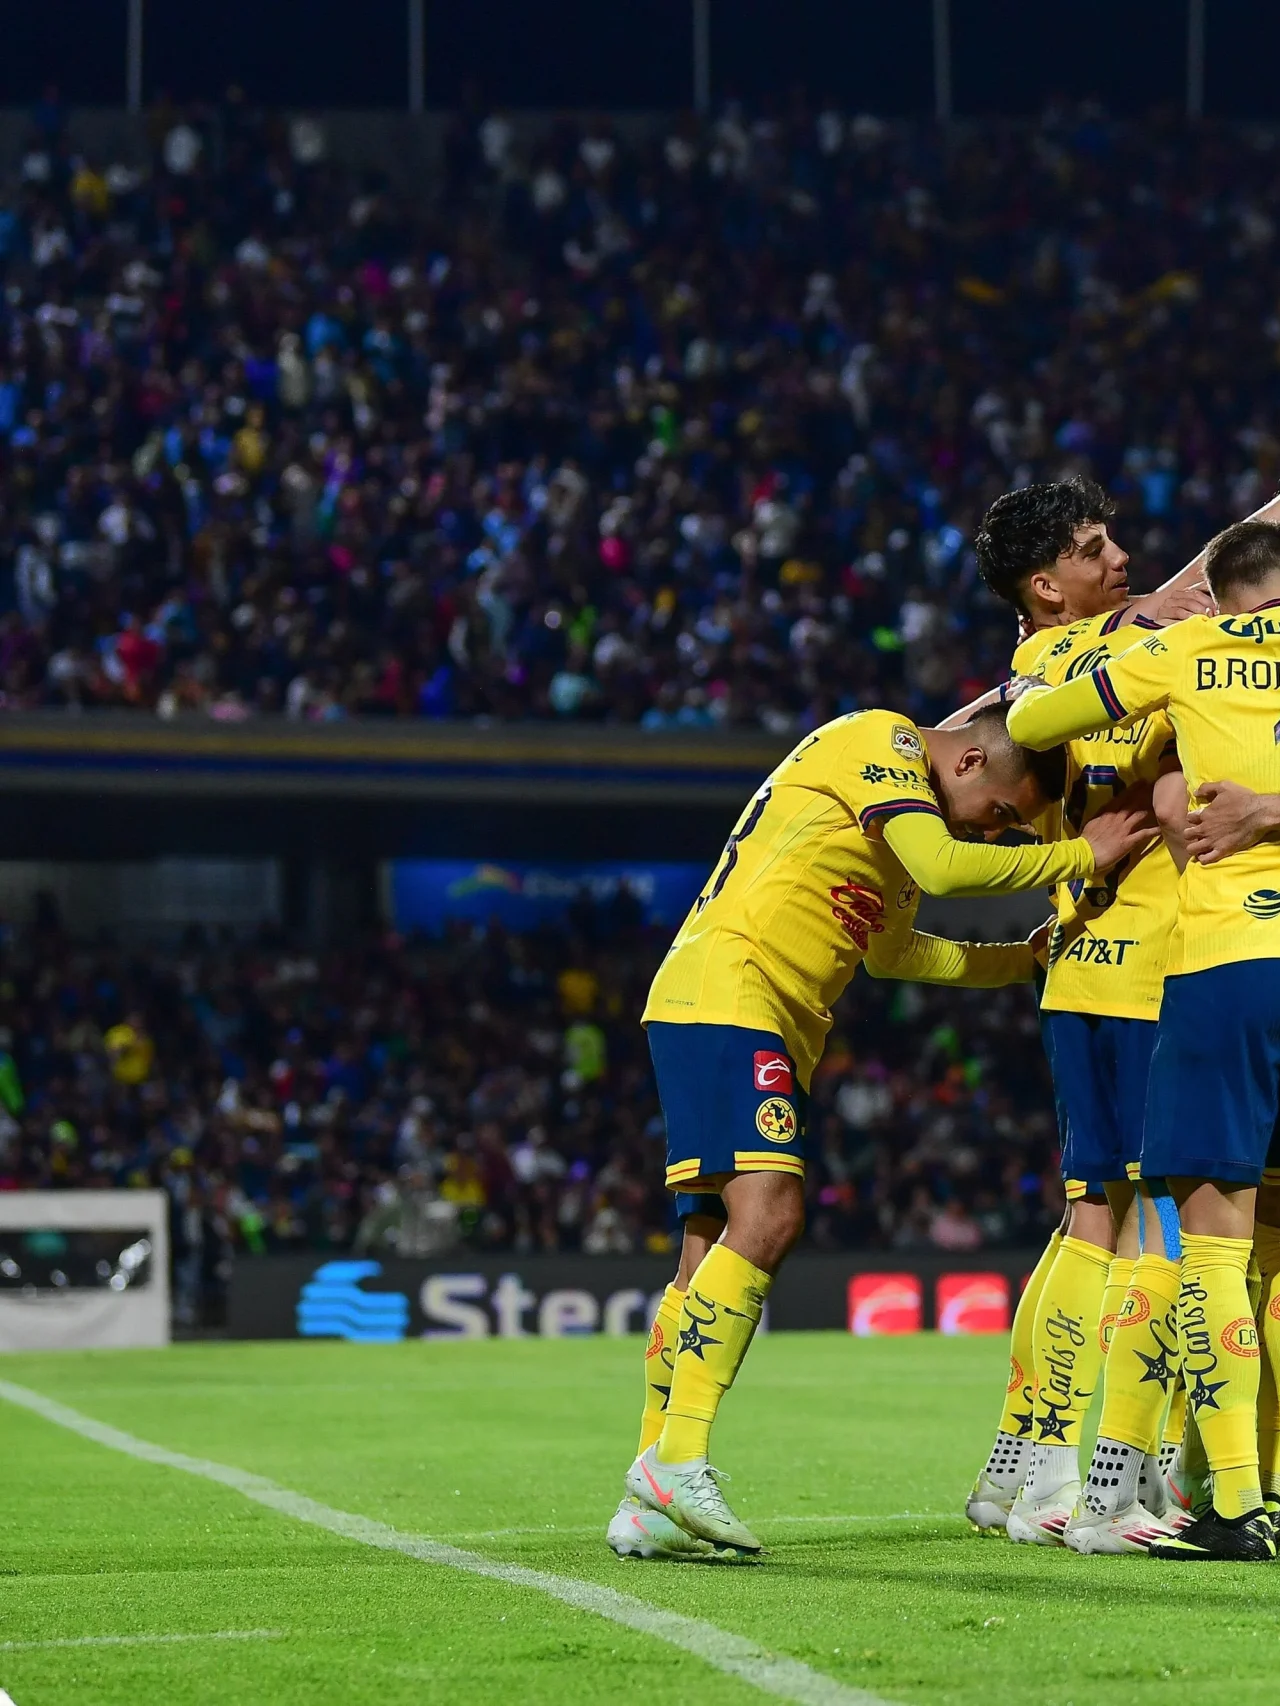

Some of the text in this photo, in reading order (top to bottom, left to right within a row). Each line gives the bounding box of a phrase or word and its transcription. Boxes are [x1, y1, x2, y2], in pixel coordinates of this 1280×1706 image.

[1064, 937, 1141, 967] AT&T
[1039, 1308, 1085, 1411] Carl's Jr.
